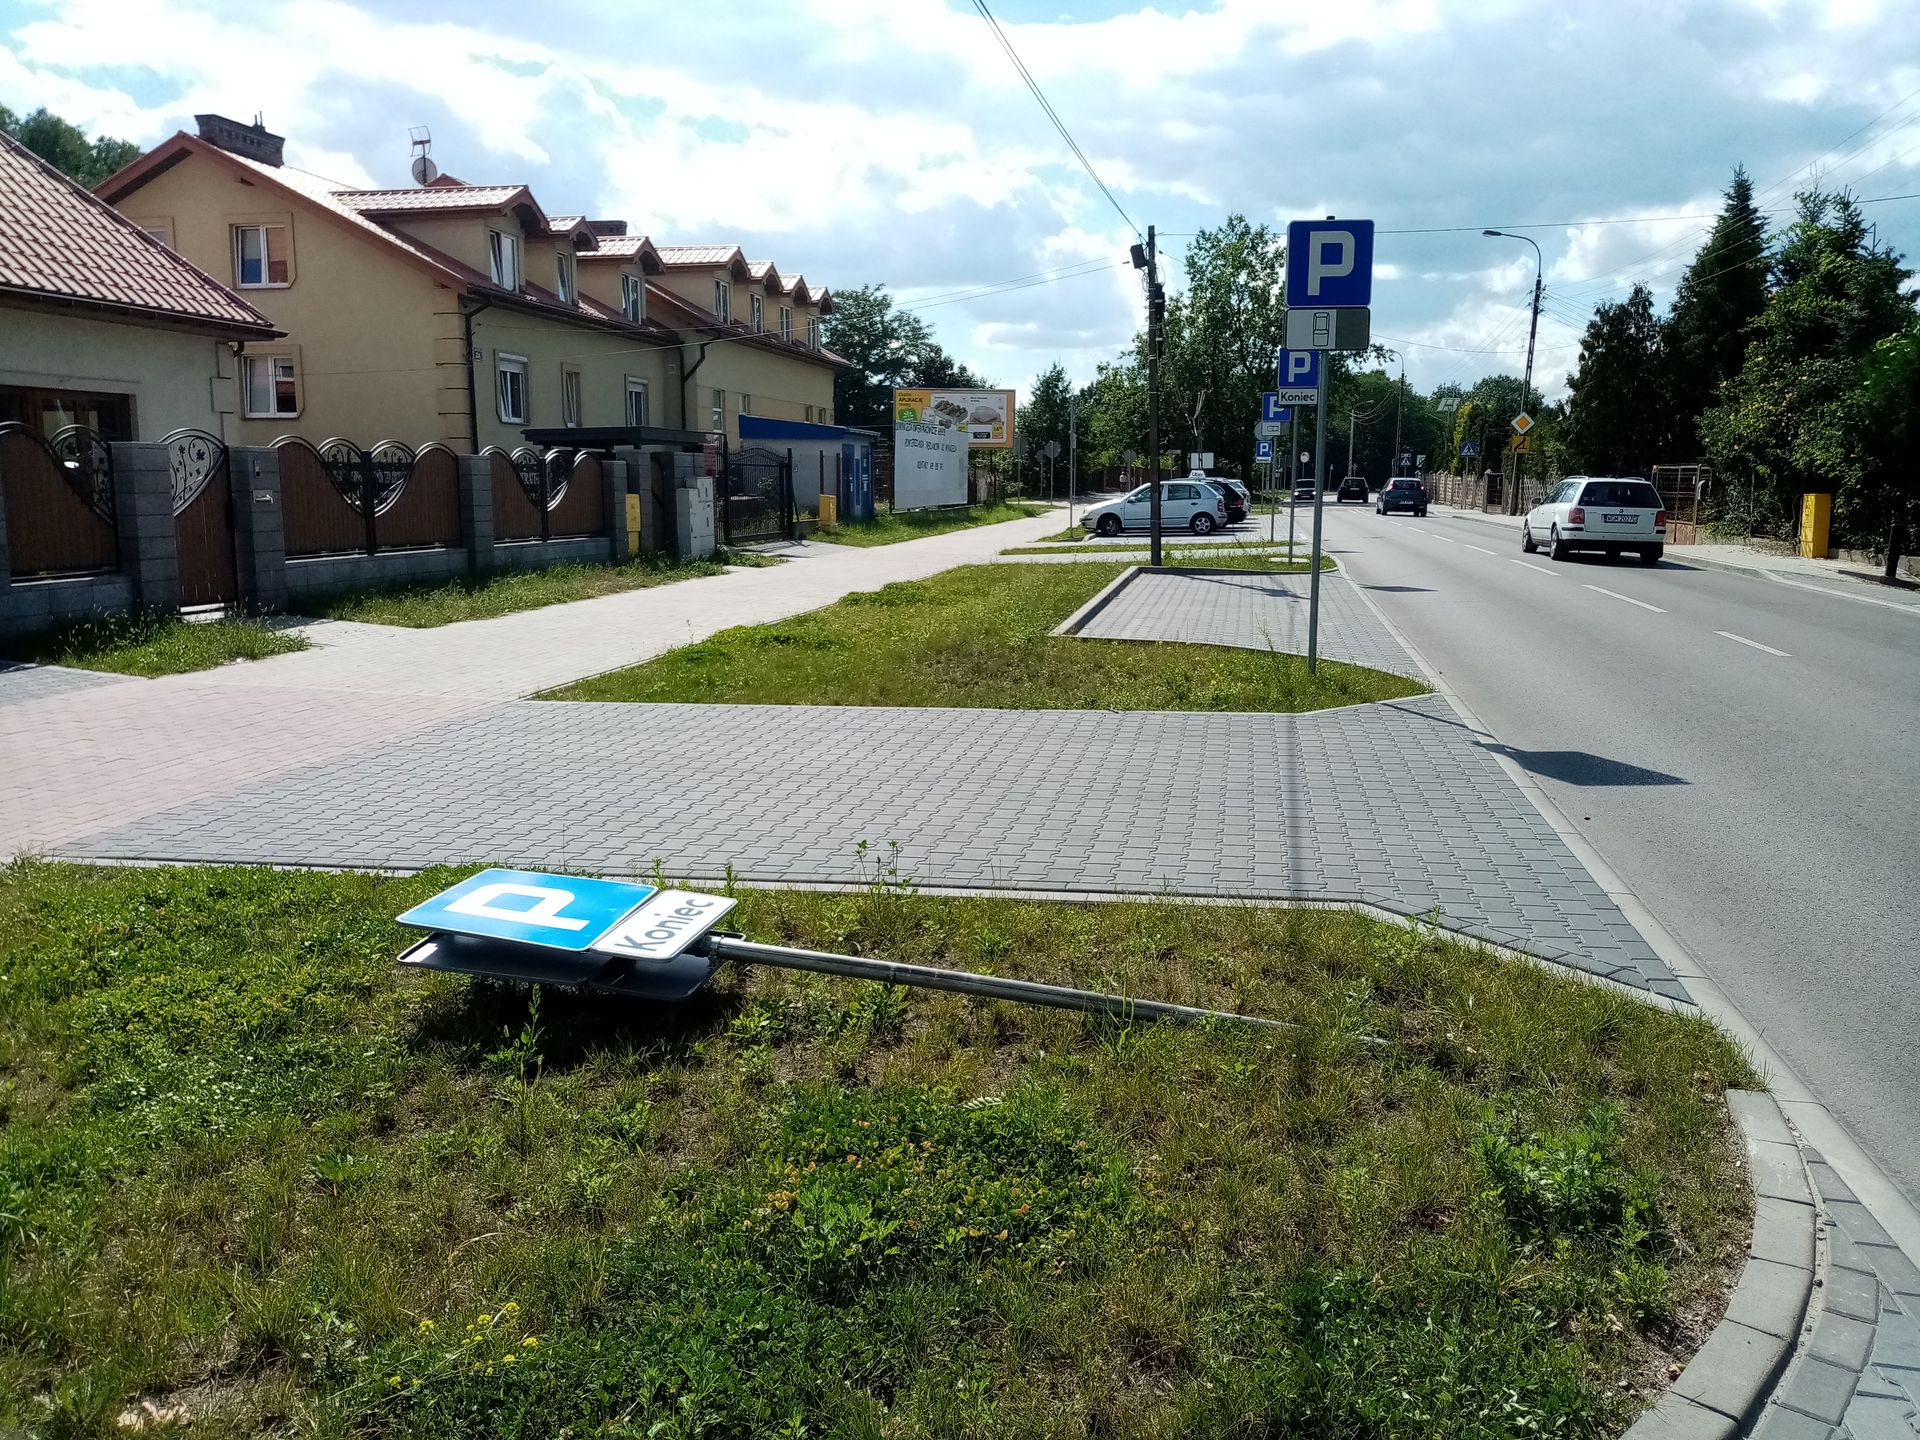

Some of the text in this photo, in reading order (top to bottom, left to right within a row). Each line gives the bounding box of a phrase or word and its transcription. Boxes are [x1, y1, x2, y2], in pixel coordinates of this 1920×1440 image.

[1308, 231, 1355, 296] P
[1288, 352, 1311, 382] P
[1281, 392, 1315, 402] Koniec
[1260, 443, 1269, 455] P
[443, 883, 591, 931] P
[614, 899, 714, 951] Koniec
